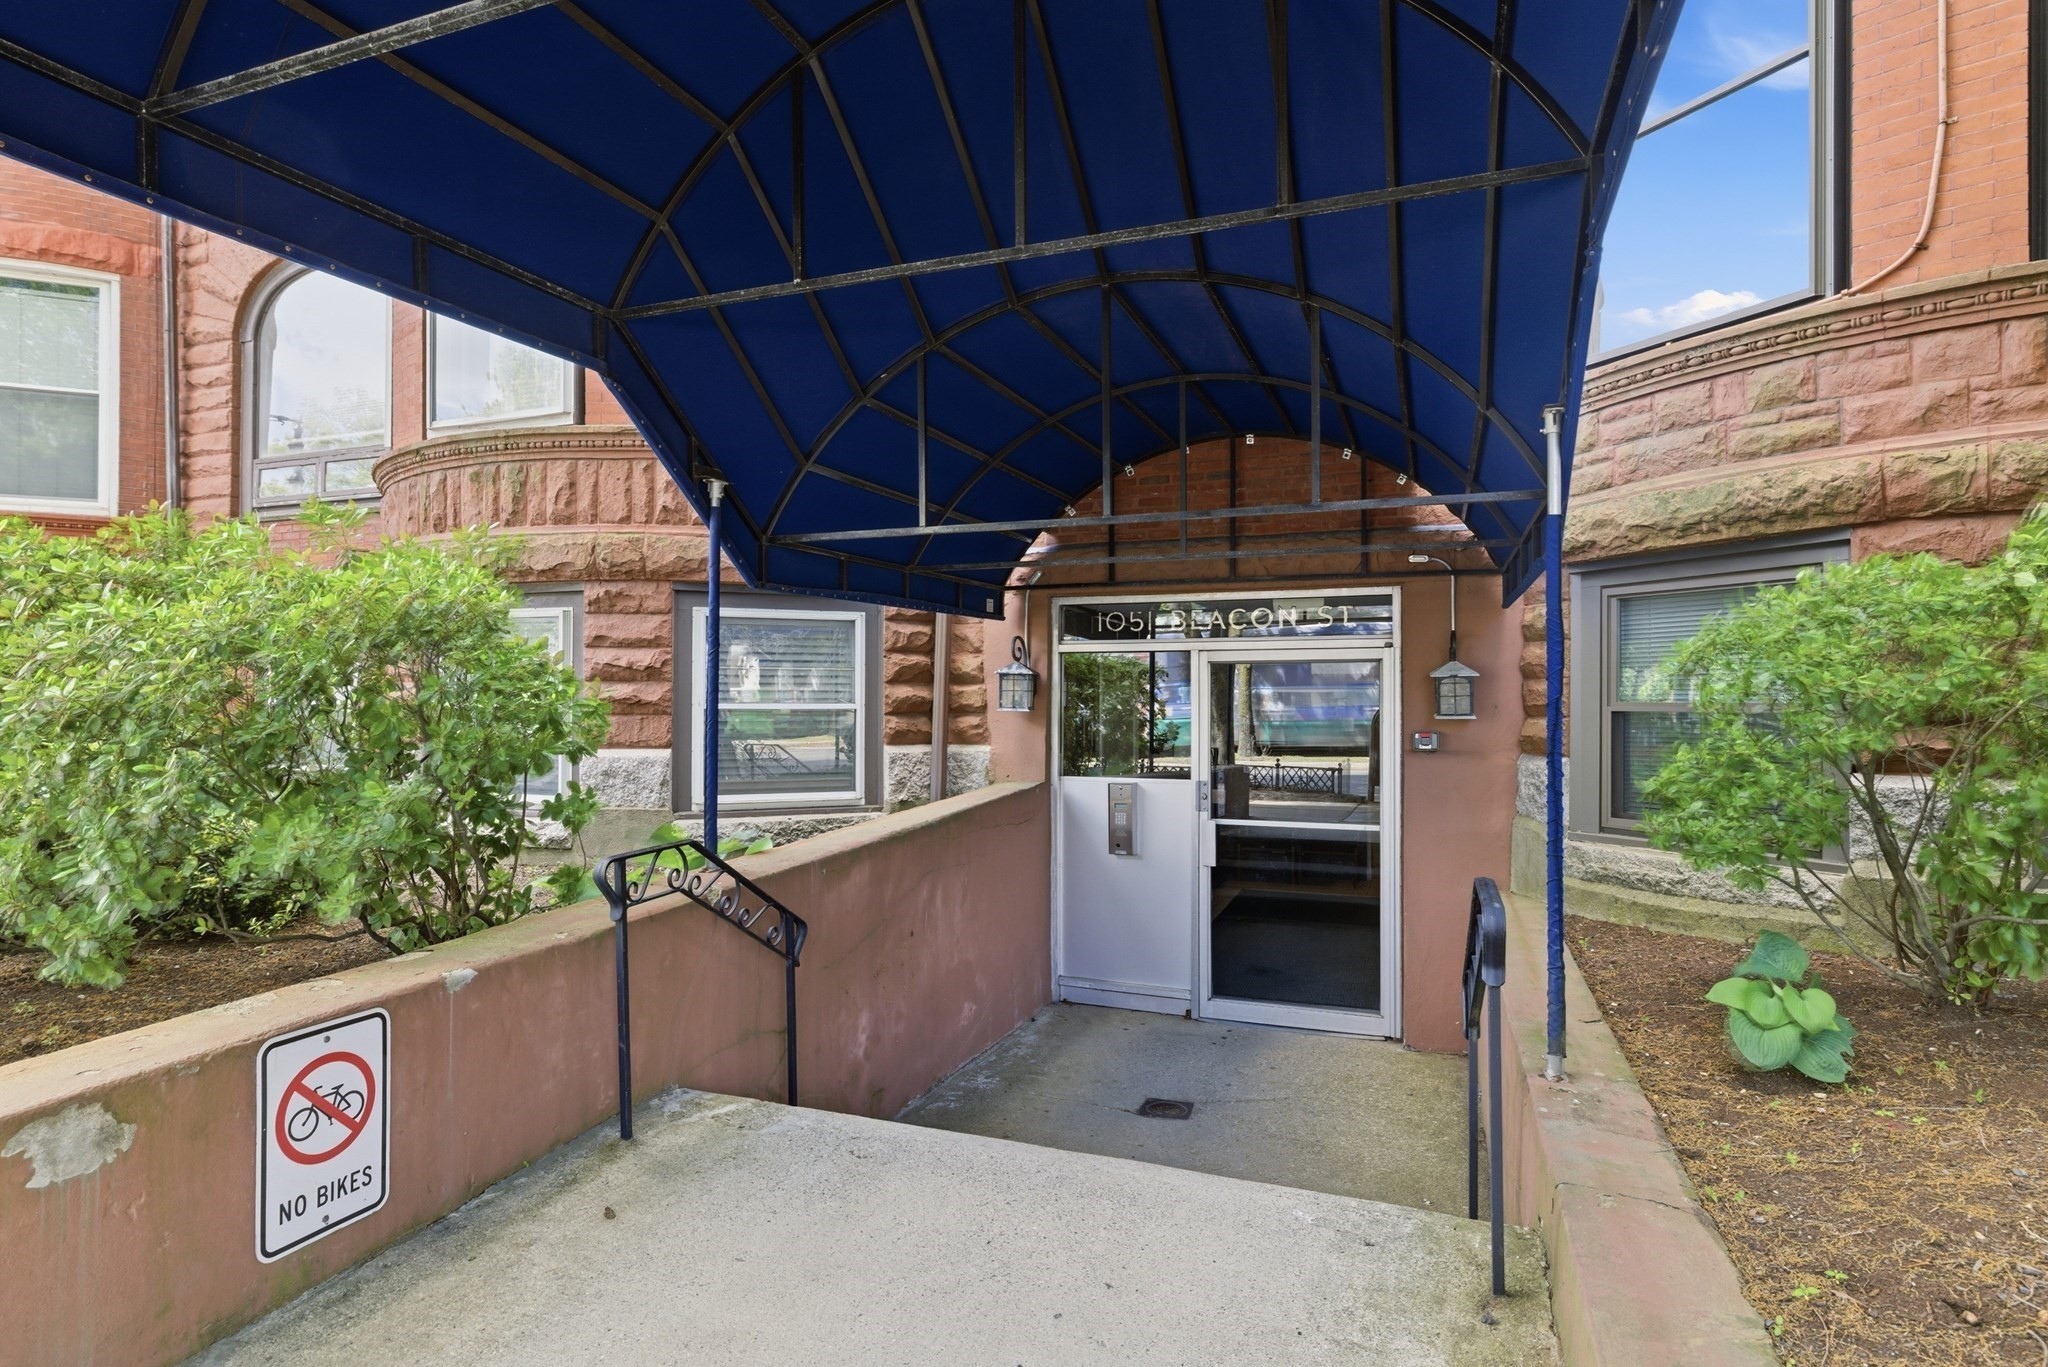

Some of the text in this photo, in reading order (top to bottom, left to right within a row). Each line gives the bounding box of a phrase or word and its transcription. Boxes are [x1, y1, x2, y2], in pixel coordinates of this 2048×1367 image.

[1098, 605, 1354, 632] 1051 BEACON ST
[278, 1165, 373, 1226] NO BIKES
